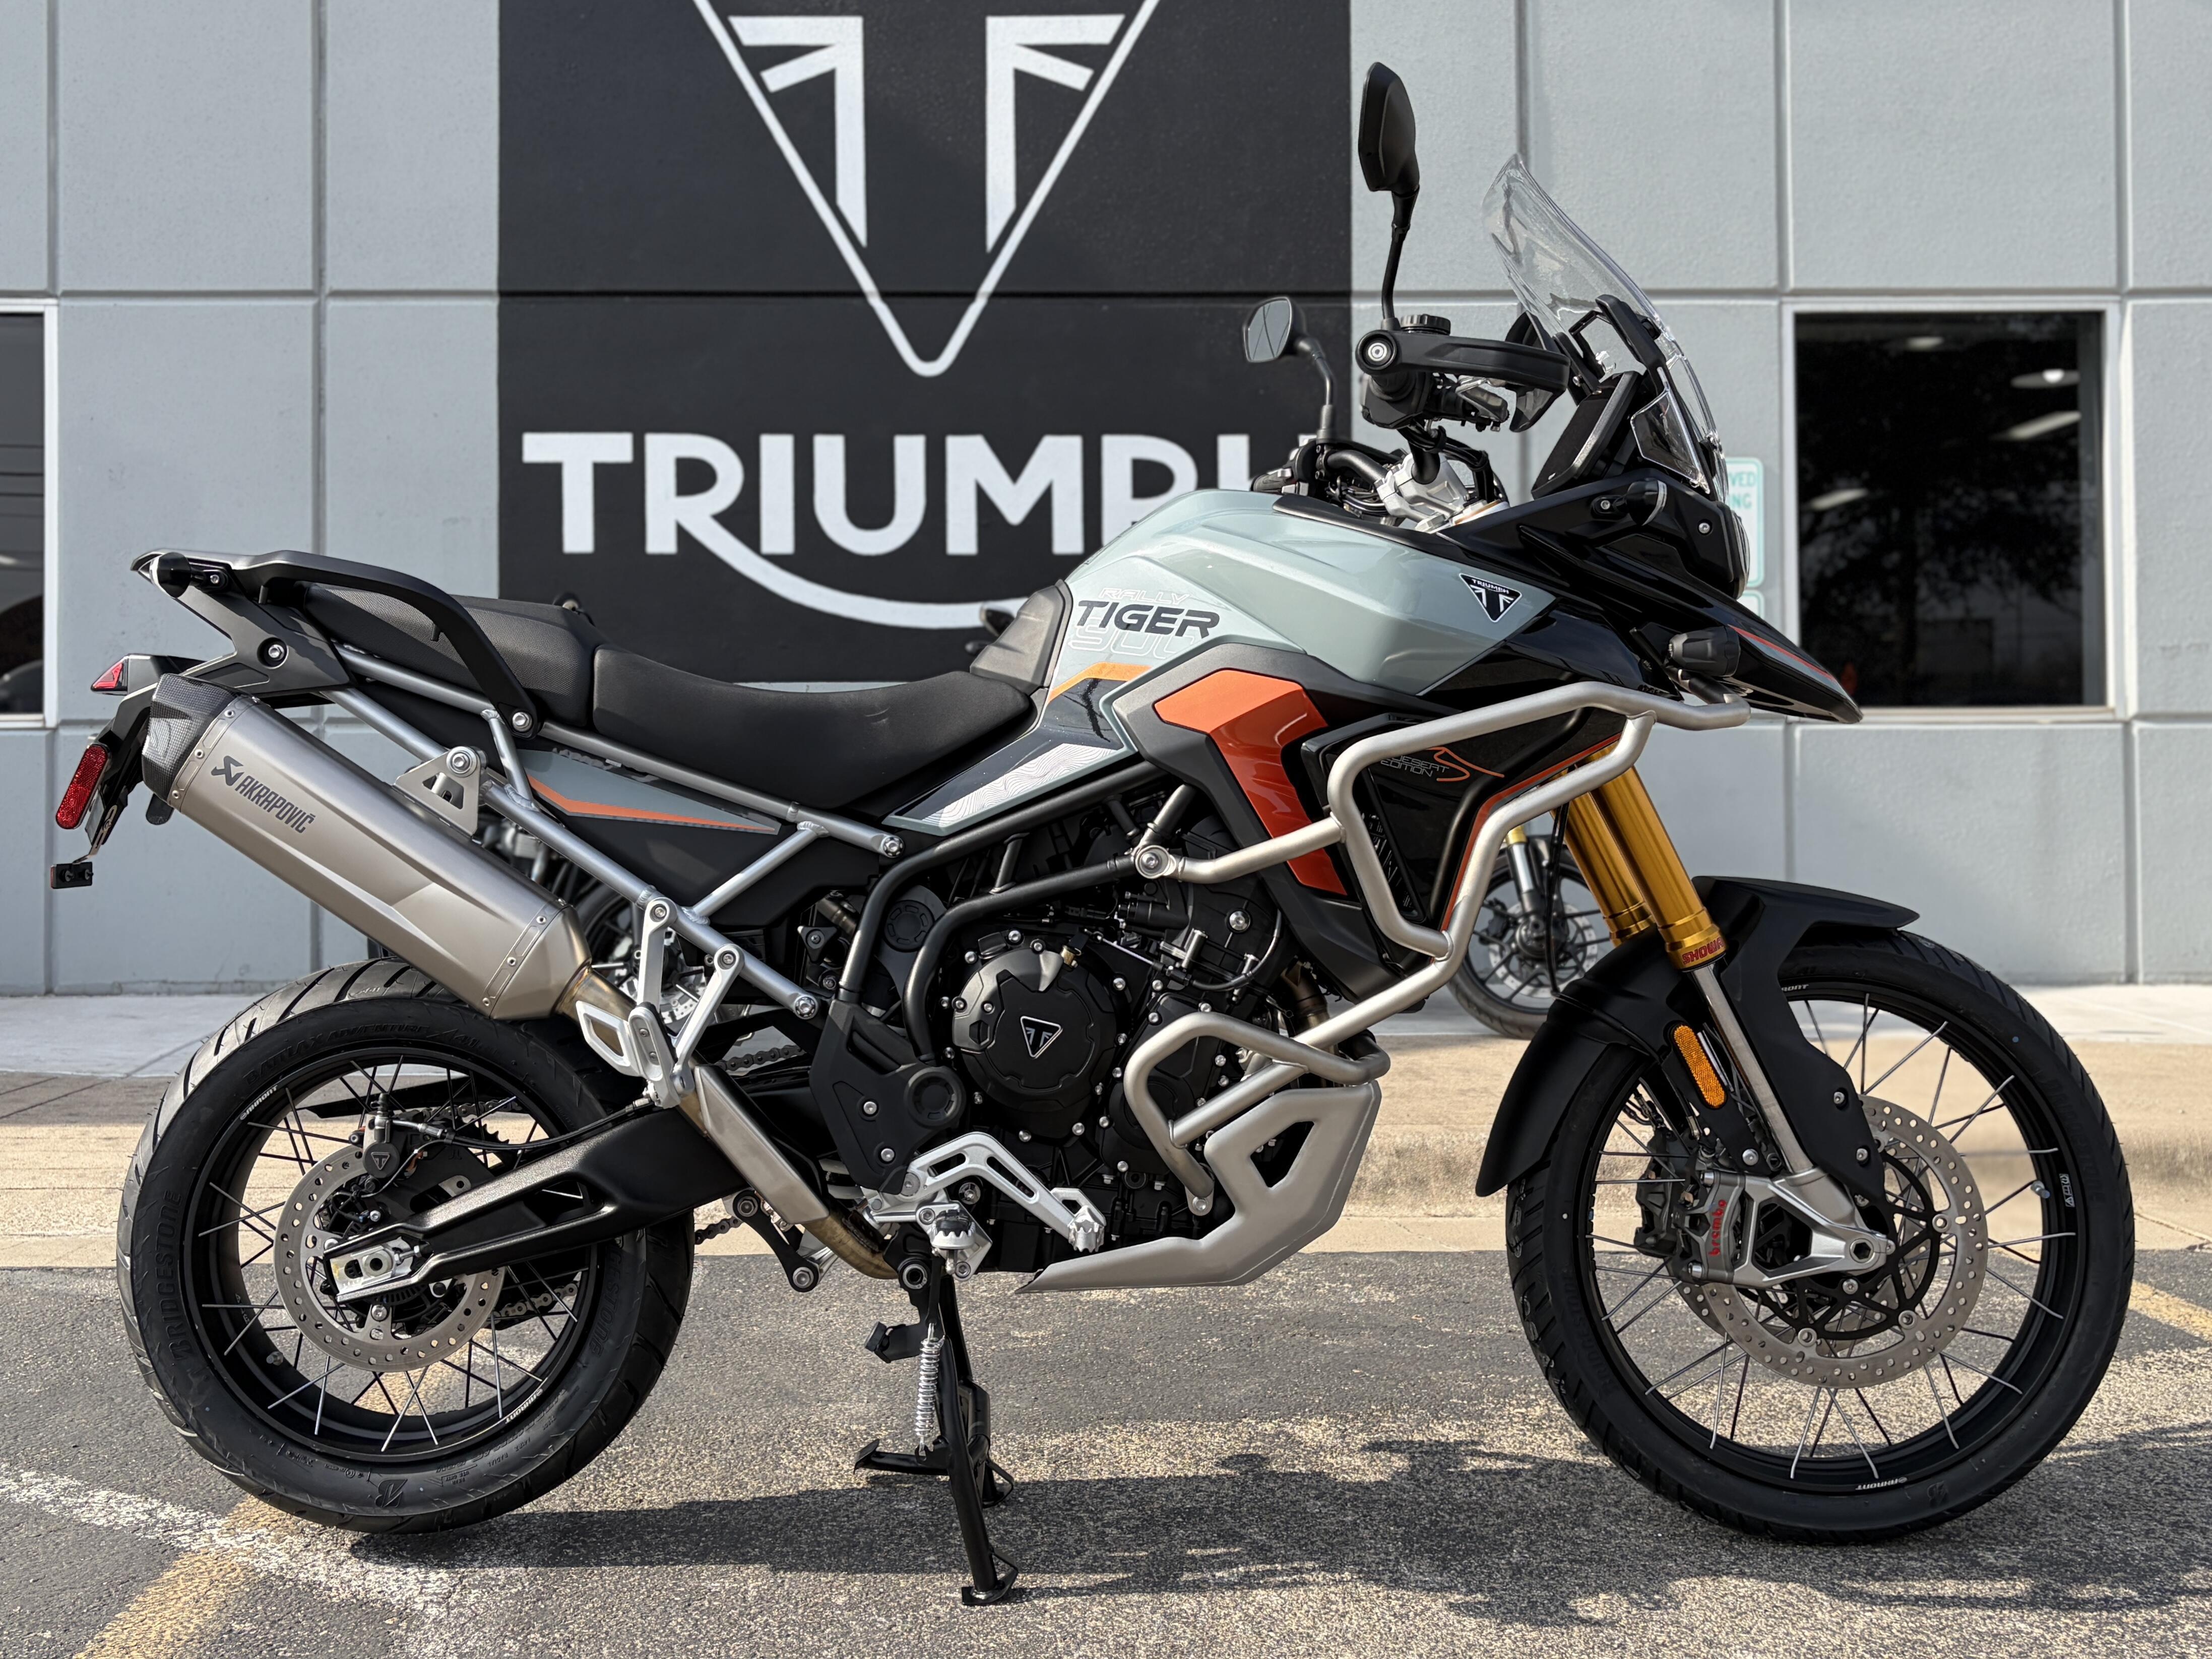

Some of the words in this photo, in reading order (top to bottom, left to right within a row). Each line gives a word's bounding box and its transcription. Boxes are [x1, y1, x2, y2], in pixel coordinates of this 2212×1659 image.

[1728, 471, 1756, 487] VED
[1098, 587, 1190, 605] RALLY
[1471, 579, 1510, 594] TRIUMPH
[1077, 600, 1220, 639] TIGER
[1380, 758, 1433, 778] EDITION
[1682, 936, 1726, 965] SHOWA
[1781, 984, 1809, 992] RONT
[242, 1033, 323, 1085] BATTLAX
[327, 1023, 430, 1042] ADVENTURE
[1708, 1199, 1727, 1257] brembo
[155, 1189, 193, 1361] BRIDGESTONE
[589, 1237, 624, 1357] GESTONE
